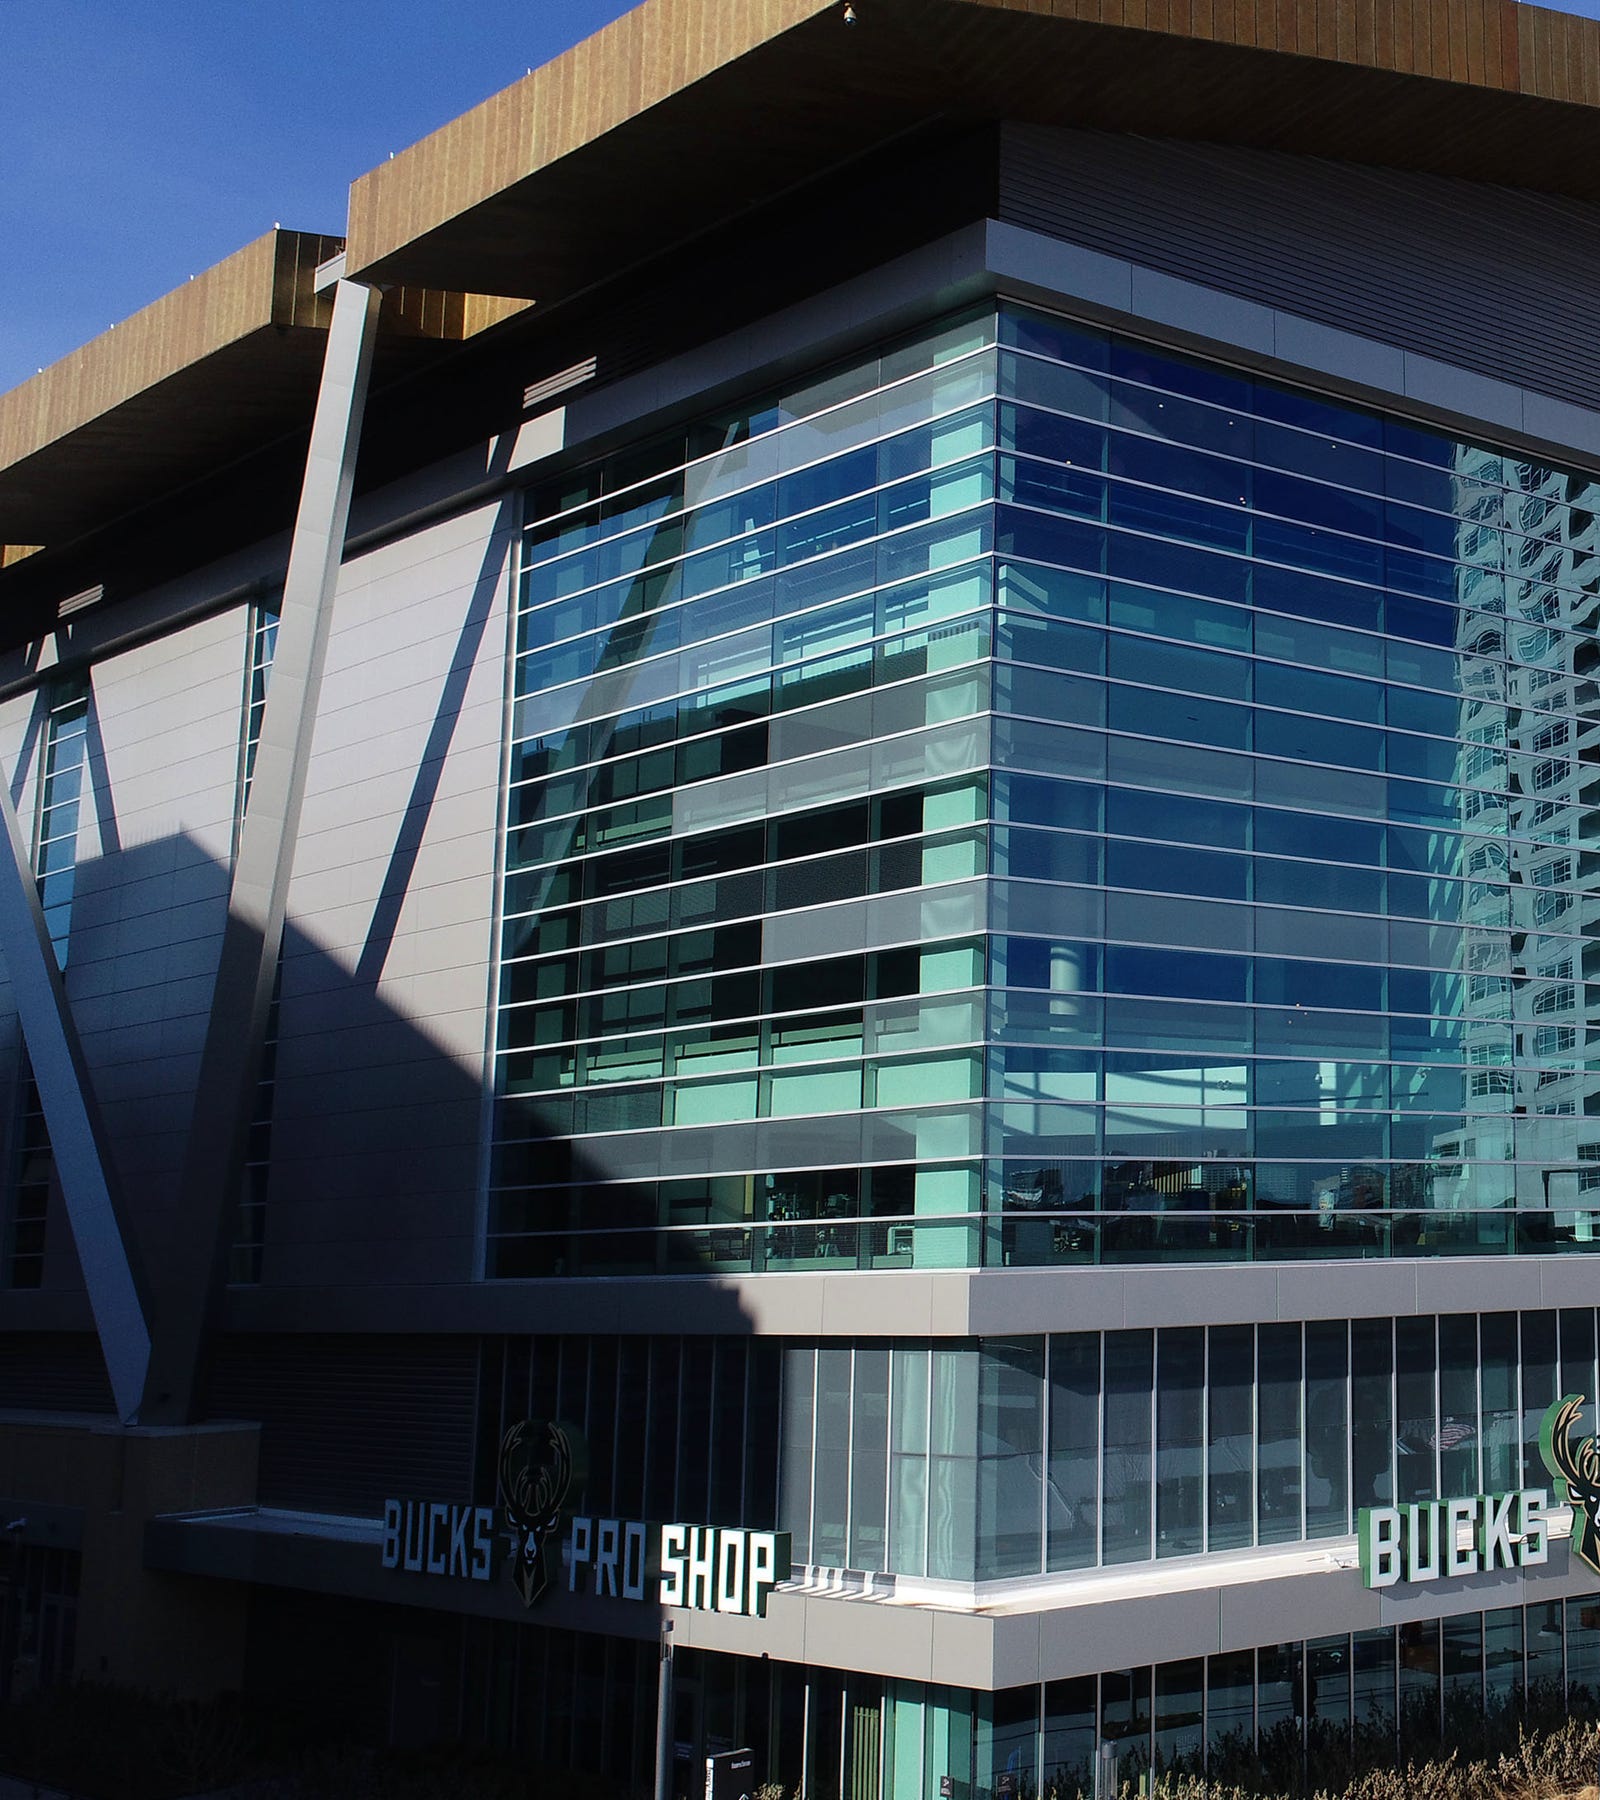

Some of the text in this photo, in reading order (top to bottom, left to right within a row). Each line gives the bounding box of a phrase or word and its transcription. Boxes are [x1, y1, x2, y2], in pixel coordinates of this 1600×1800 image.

[382, 1500, 787, 1618] BUCKS PRO SHOP
[1359, 1490, 1548, 1587] BUCKS
